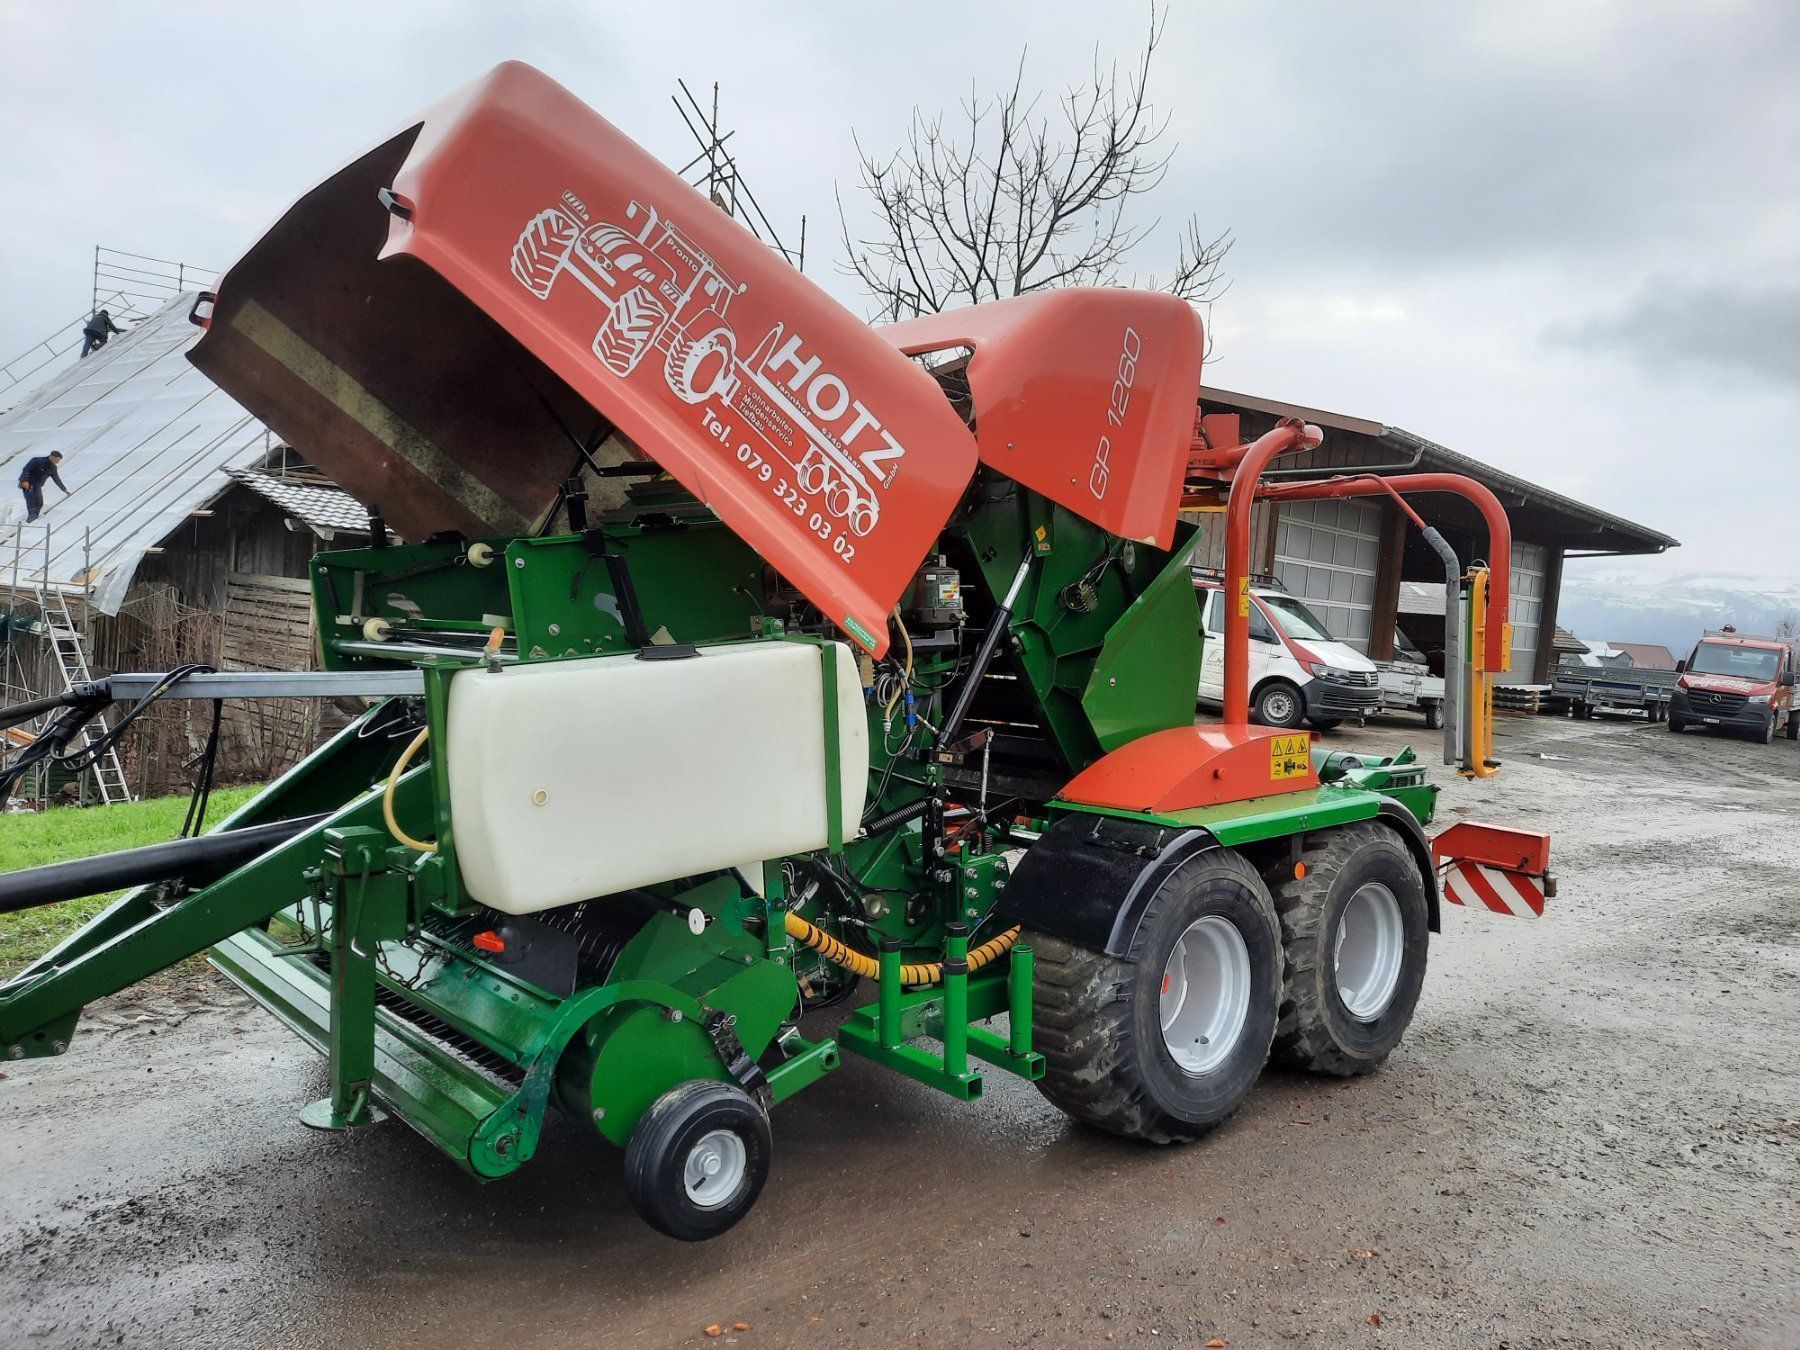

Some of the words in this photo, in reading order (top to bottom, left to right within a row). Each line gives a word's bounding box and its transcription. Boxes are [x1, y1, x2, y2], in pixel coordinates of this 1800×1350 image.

[667, 237, 699, 273] Pronto
[738, 401, 765, 431] Tiefbau
[742, 394, 793, 447] Muldenservice
[747, 386, 793, 435] Lohnarbeiten
[767, 334, 906, 482] HOTZ
[776, 380, 812, 418] Tannhof
[1089, 435, 1110, 500] GP
[1107, 326, 1141, 427] 1260
[701, 406, 730, 448] Tel.
[736, 443, 772, 482] 079
[772, 478, 808, 517] 323
[809, 512, 832, 540] 03
[833, 535, 855, 564] 02
[882, 462, 899, 490] GmbH
